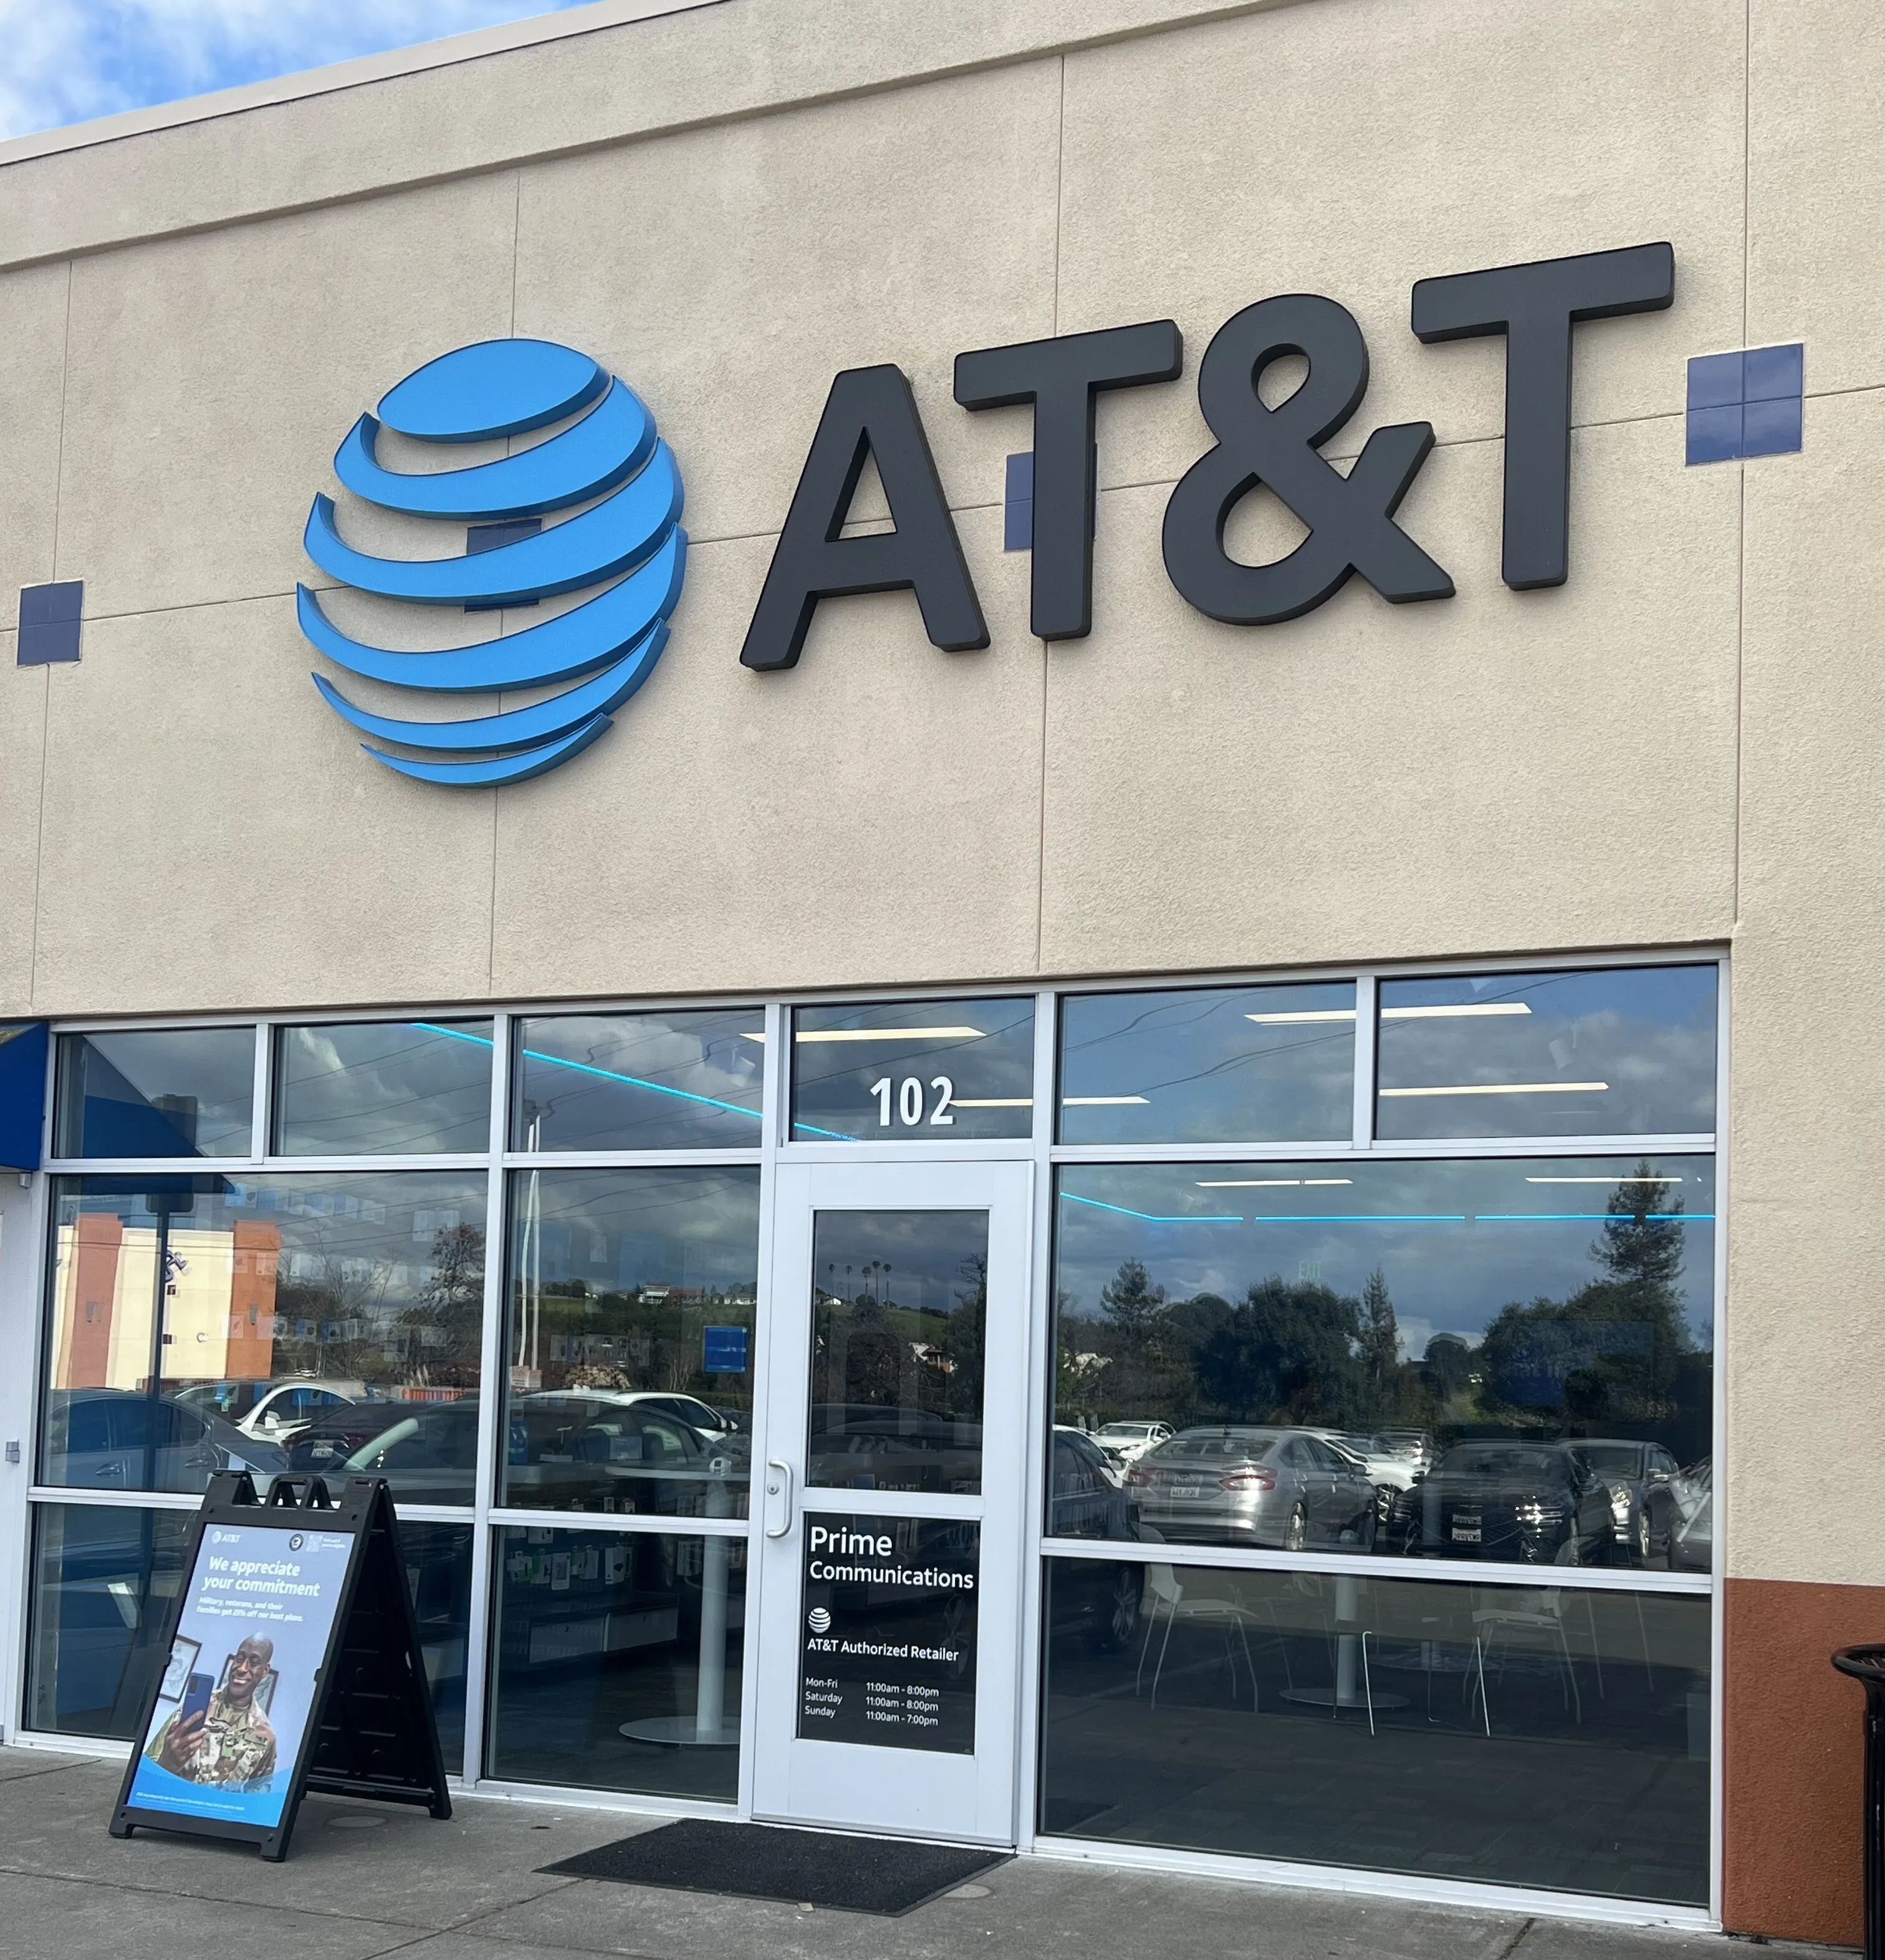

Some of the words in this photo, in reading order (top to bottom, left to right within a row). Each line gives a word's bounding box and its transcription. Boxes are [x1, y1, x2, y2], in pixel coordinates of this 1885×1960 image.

[739, 241, 1675, 671] AT&T
[870, 1076, 953, 1126] 102
[1298, 1261, 1321, 1280] EXIT
[221, 1534, 241, 1543] AT&T
[810, 1526, 893, 1556] Prime
[209, 1556, 229, 1571] We
[230, 1560, 300, 1577] appreciate
[810, 1561, 974, 1588] Communications
[201, 1576, 234, 1591] your
[235, 1578, 320, 1597] commitment
[807, 1638, 839, 1653] AT&T
[841, 1640, 908, 1657] Authorized
[911, 1645, 959, 1661] Retailer
[806, 1677, 838, 1689] Mon-Fri
[866, 1682, 899, 1694] 11:00am
[907, 1686, 939, 1698] 8:00pm
[805, 1691, 843, 1705] Saturday
[866, 1696, 899, 1708] 11:00am
[906, 1700, 939, 1712] 8:00pm
[805, 1706, 836, 1719] Sunday
[866, 1711, 899, 1722] 11:00am
[907, 1714, 939, 1726] 7:00pm
